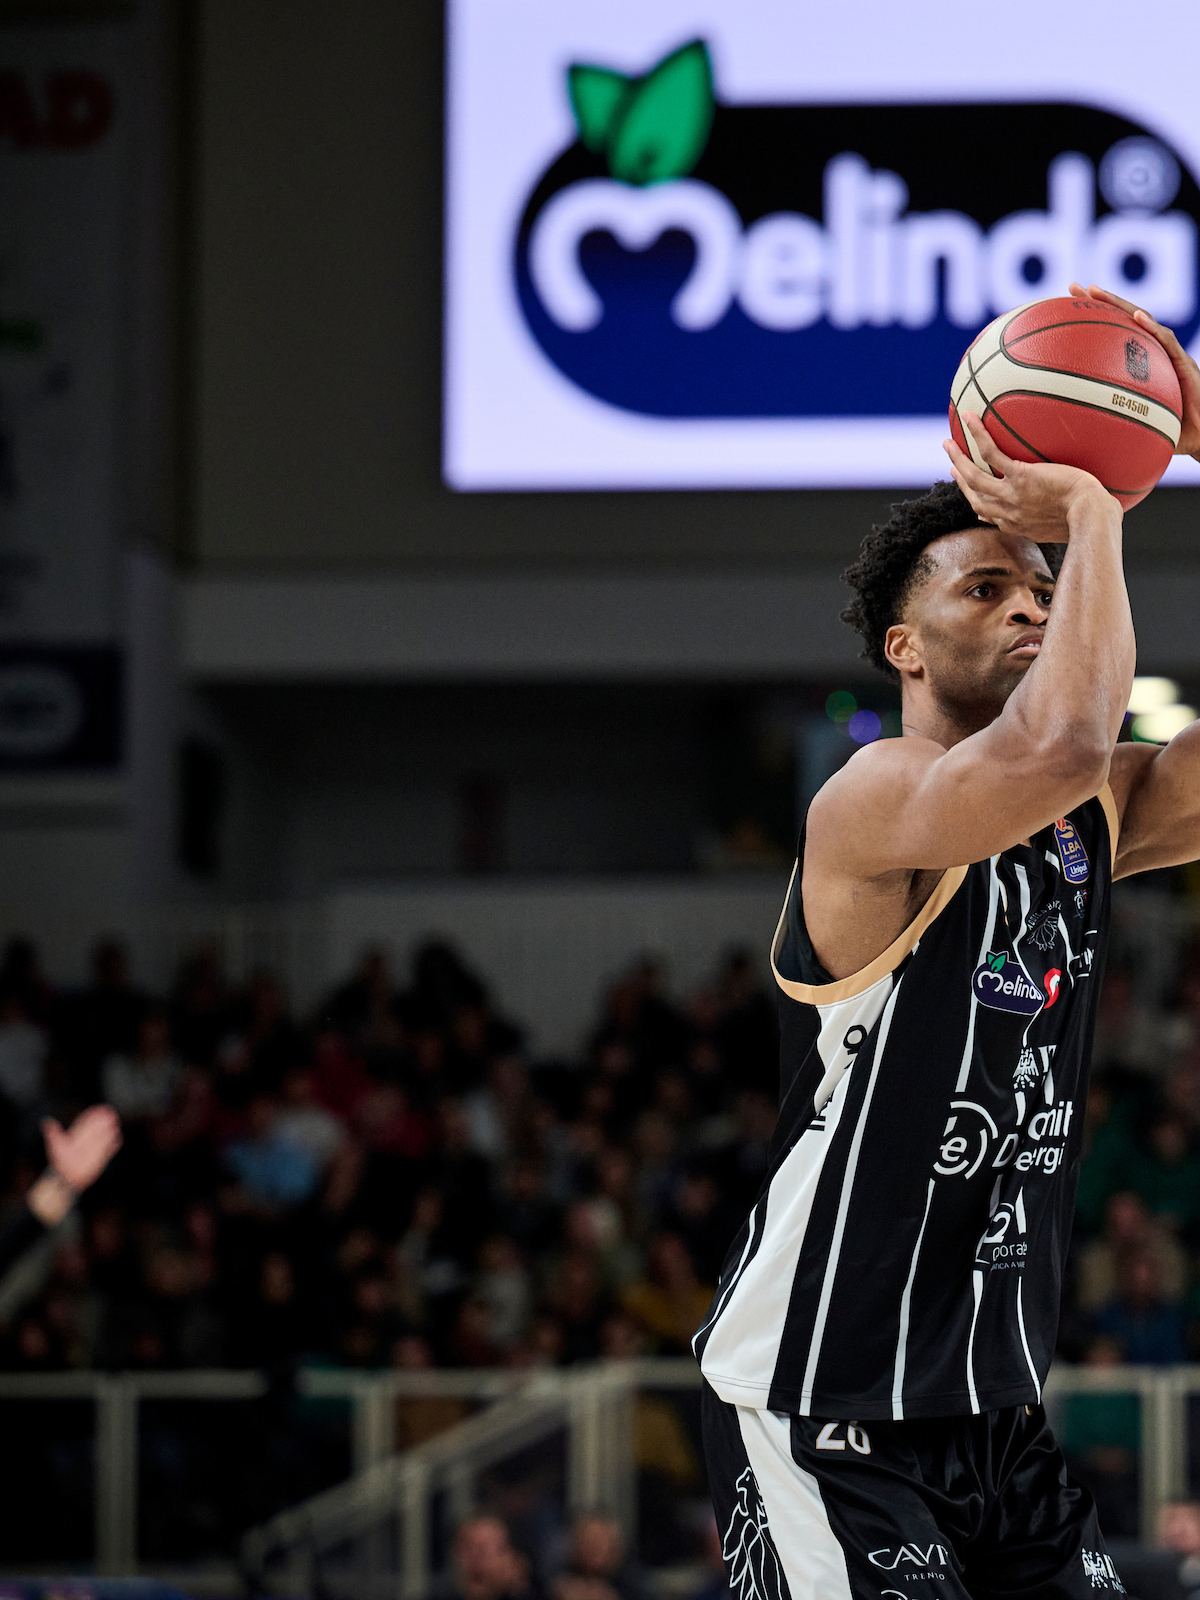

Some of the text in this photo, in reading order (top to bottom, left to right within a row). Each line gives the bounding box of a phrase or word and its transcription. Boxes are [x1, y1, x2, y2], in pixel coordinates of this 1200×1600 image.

[529, 151, 1197, 332] Melinda
[1111, 393, 1149, 417] BG4500
[1062, 840, 1081, 855] LBA
[1070, 862, 1087, 876] Unipol
